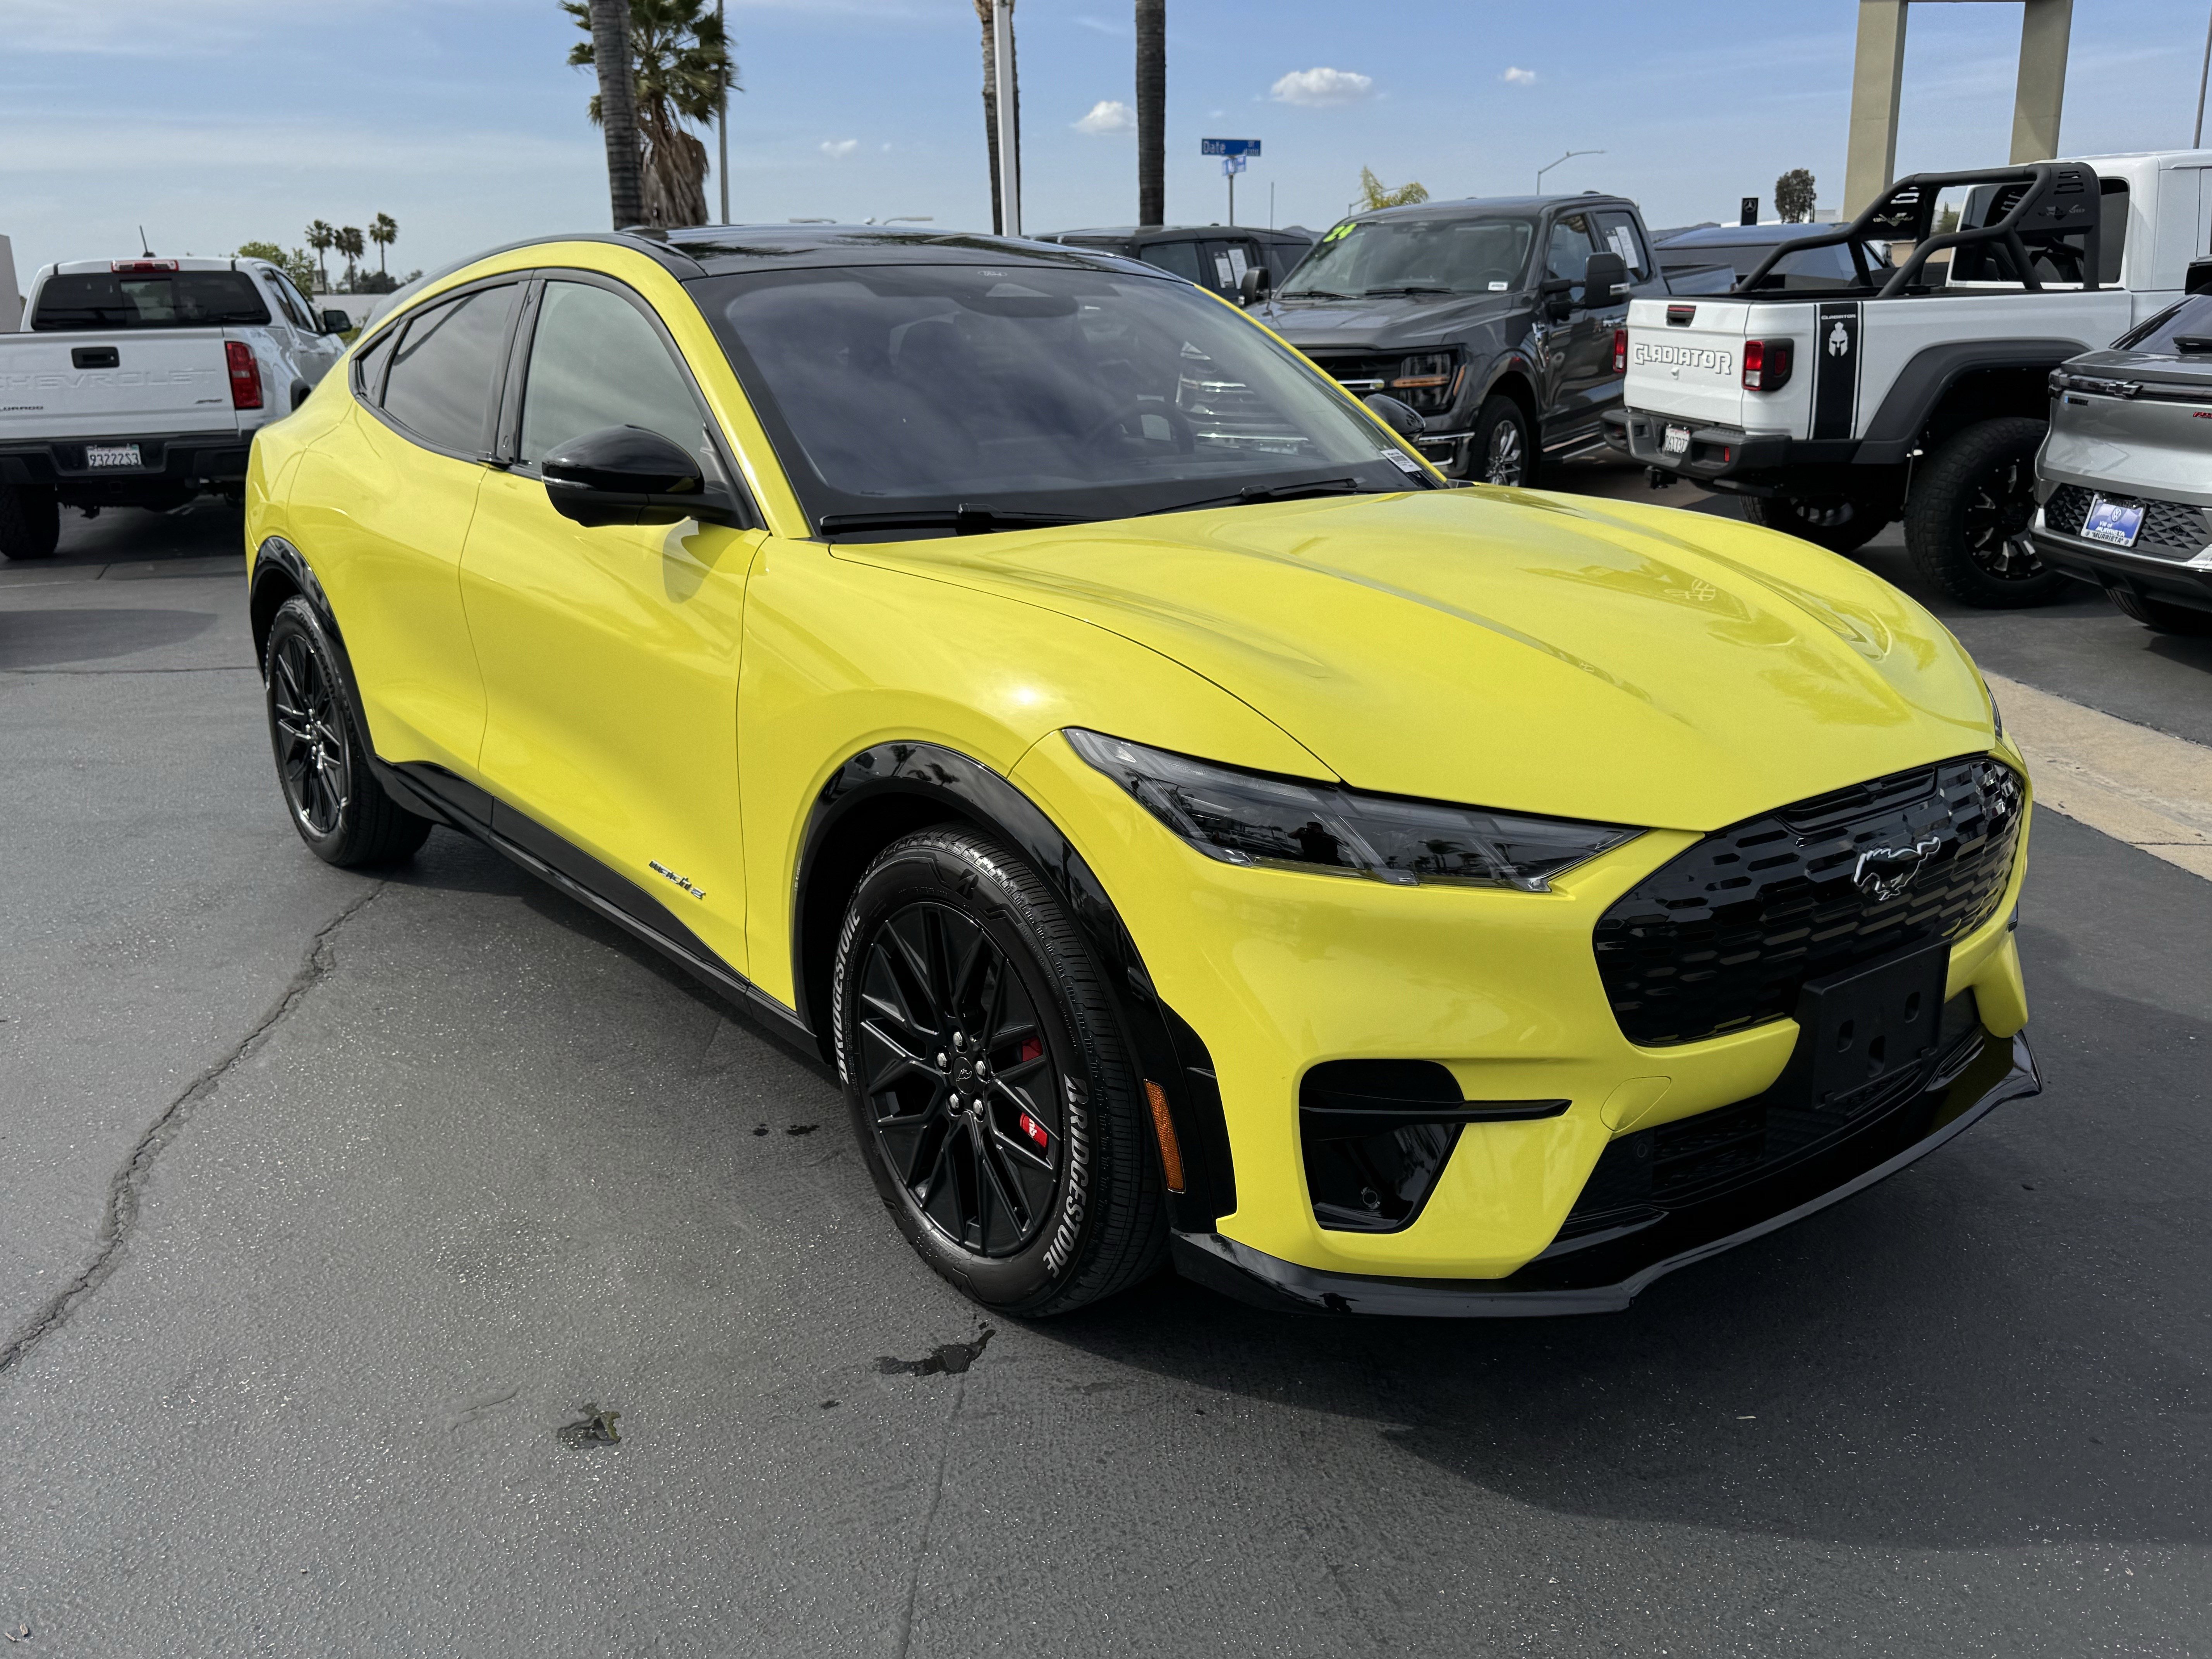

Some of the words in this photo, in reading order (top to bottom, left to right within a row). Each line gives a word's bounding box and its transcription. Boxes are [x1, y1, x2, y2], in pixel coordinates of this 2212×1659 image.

[1203, 141, 1226, 154] Date
[1634, 343, 1732, 374] GLADIATOR
[0, 369, 215, 390] HEVROLET
[833, 908, 860, 1085] BRIDGESTONE
[1043, 1073, 1089, 1279] BRIDGESTONE
